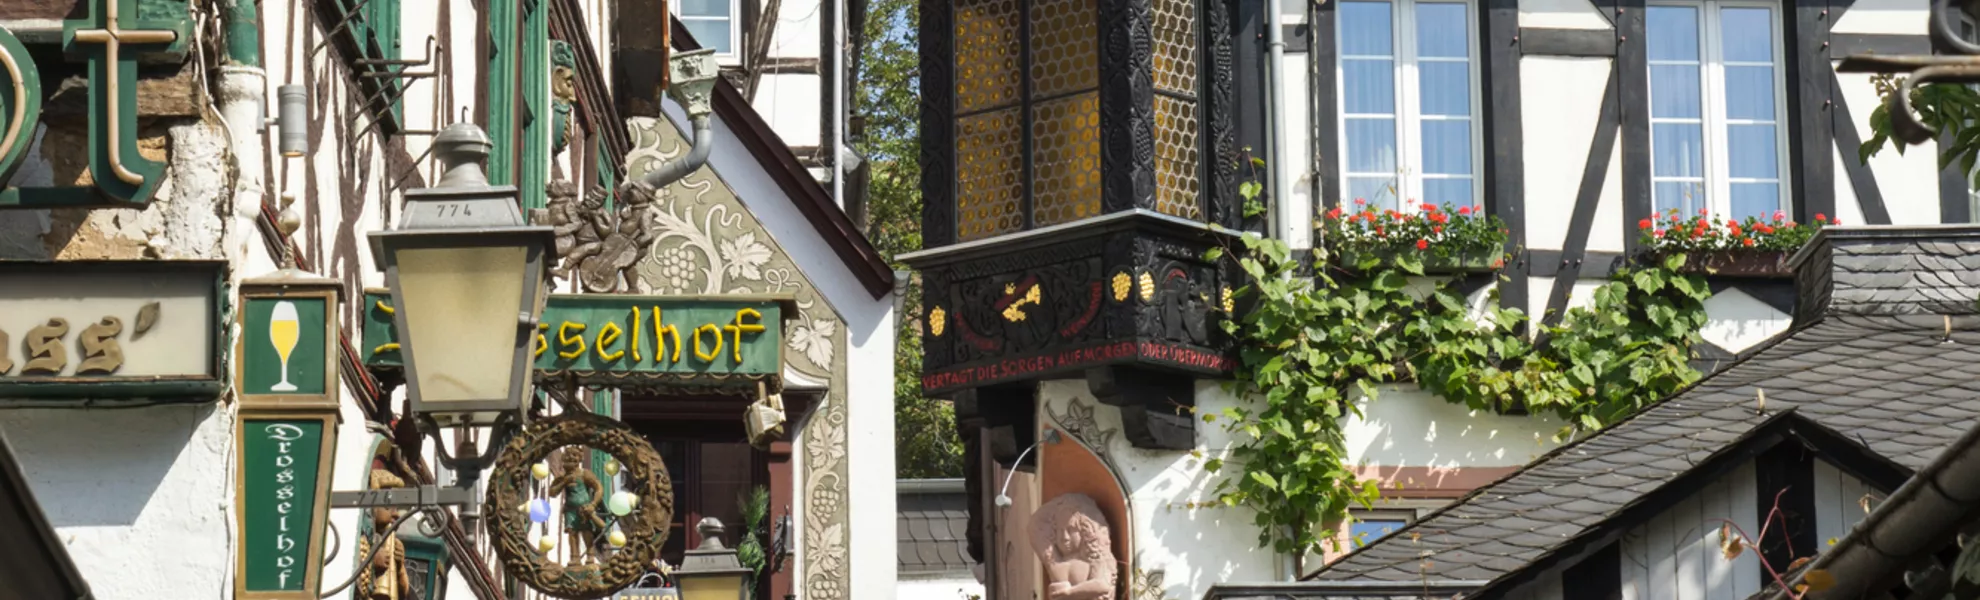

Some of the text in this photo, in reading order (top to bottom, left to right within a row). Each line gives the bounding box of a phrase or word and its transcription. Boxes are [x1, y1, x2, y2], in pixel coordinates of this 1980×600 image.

[0, 302, 161, 375] ss'
[922, 342, 1239, 389] VERTAGT DIE SORGEN AUF MORGEN ODER ÜBERMOR
[265, 423, 304, 590] Drosselhof
